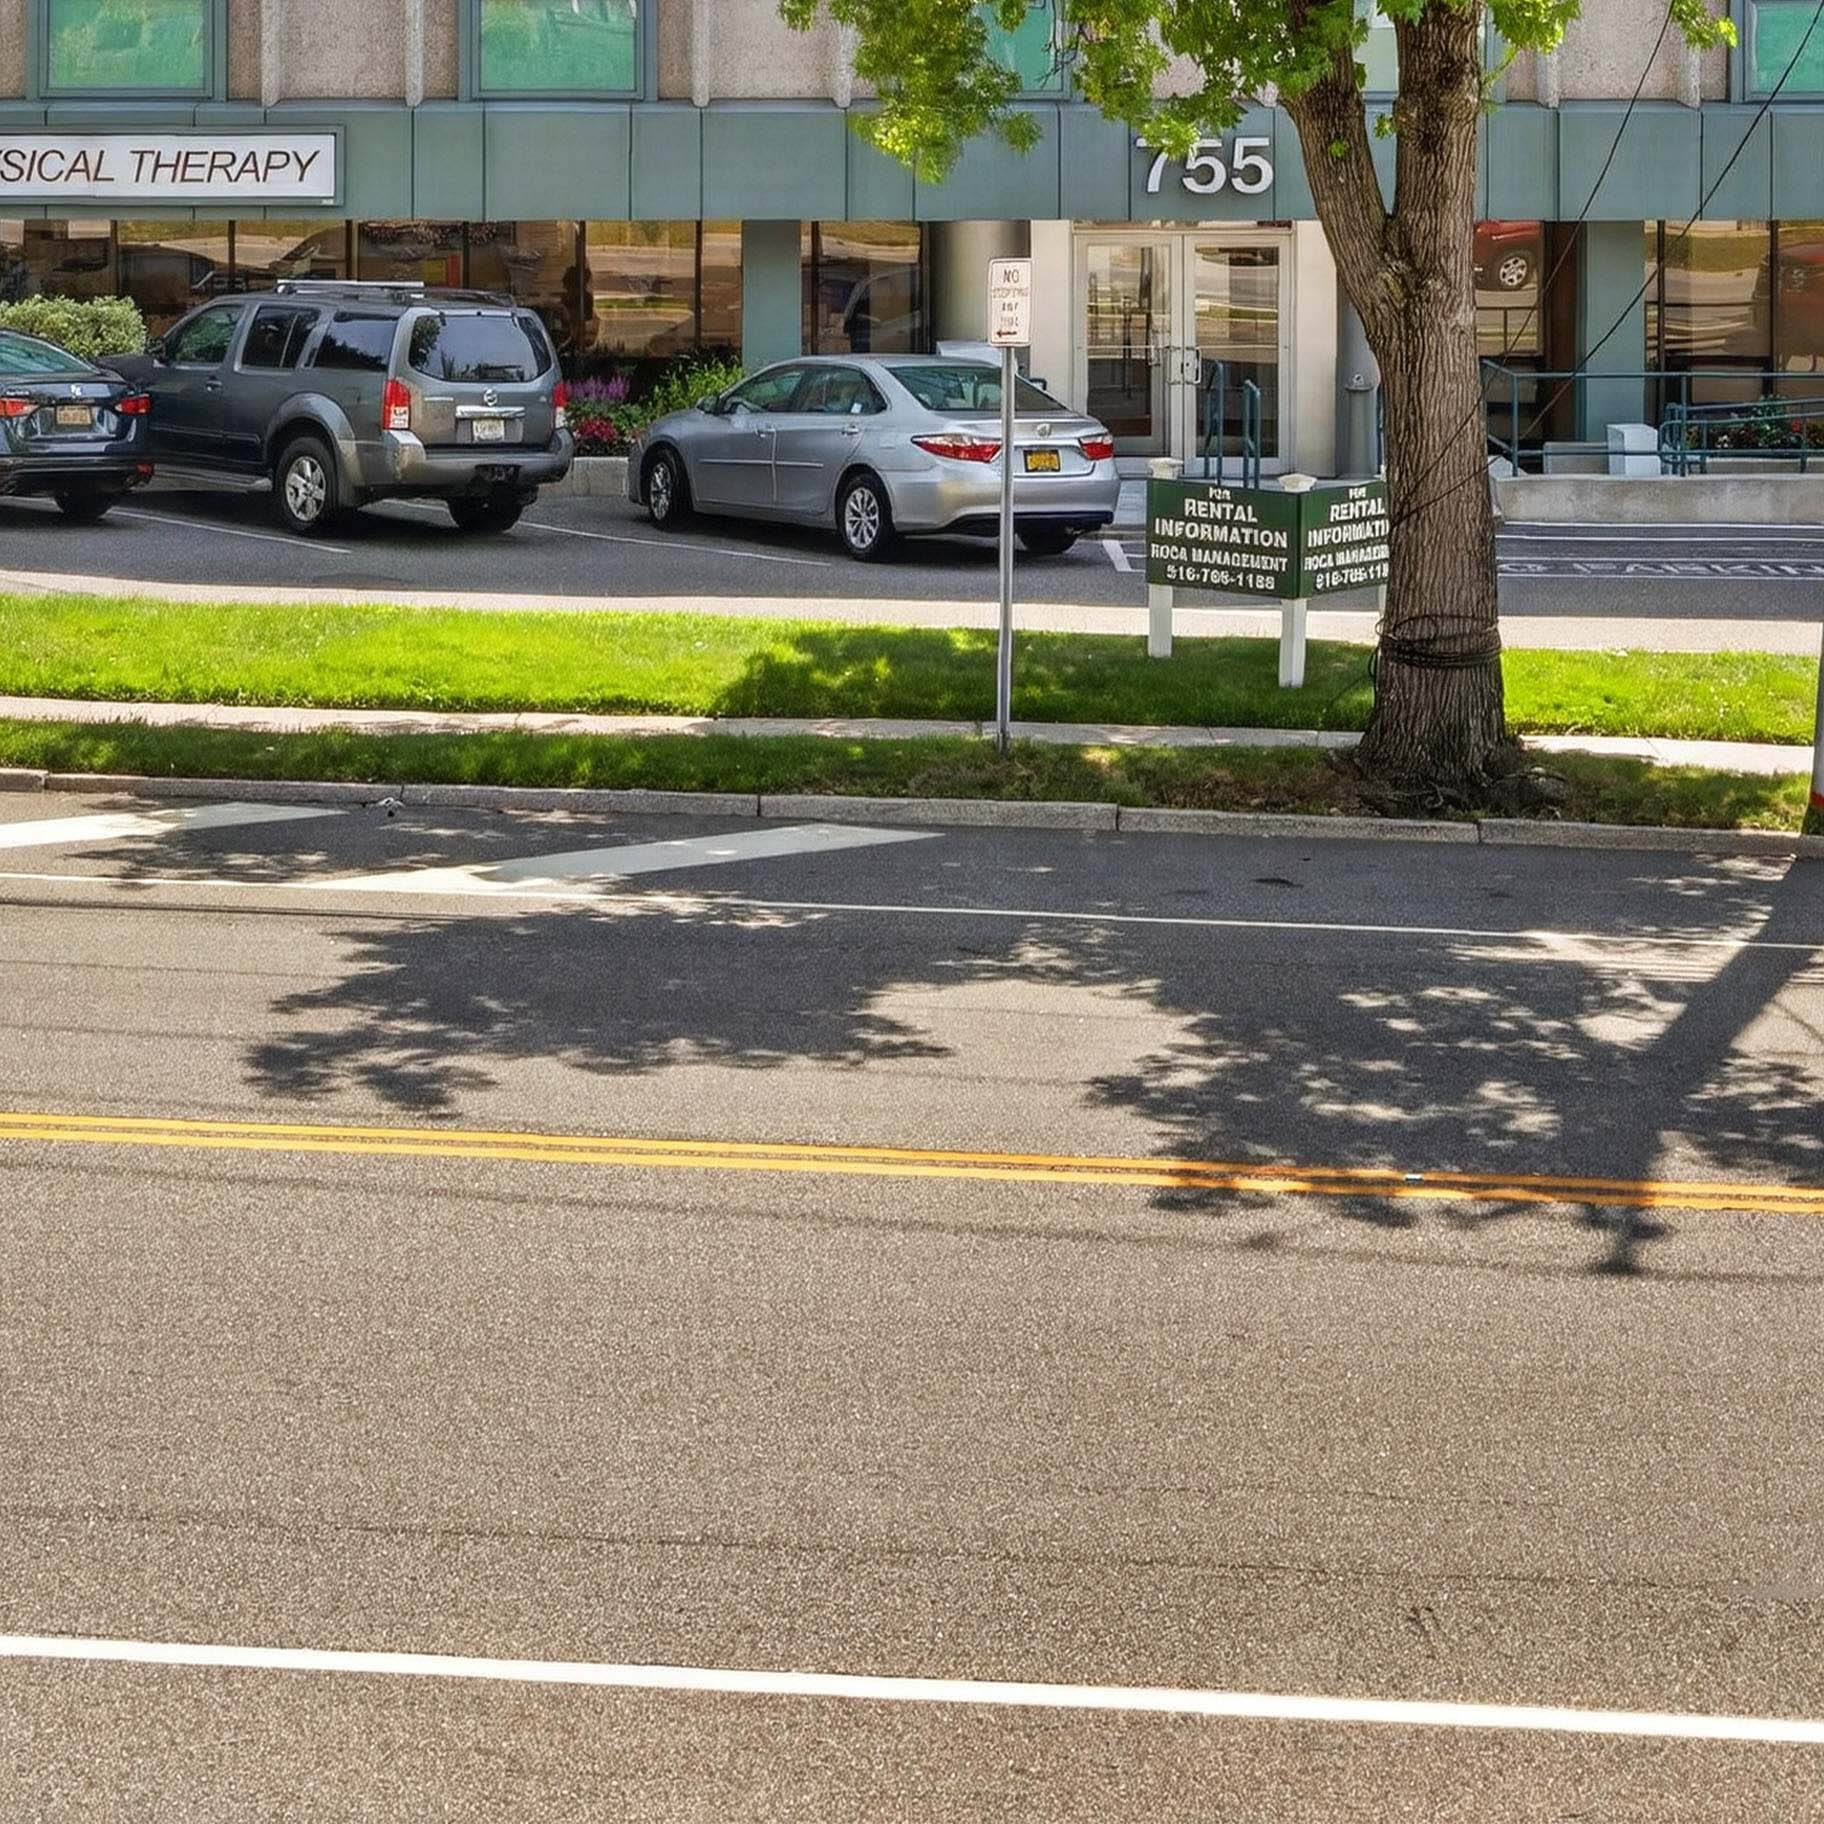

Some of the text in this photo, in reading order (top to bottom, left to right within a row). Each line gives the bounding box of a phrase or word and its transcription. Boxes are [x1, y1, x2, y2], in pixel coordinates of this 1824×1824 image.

[130, 150, 321, 184] THERAPY
[1136, 137, 1273, 194] 755
[1003, 269, 1020, 284] NO
[1184, 498, 1258, 523] RENTAL
[1330, 498, 1386, 522] RENTAL
[1155, 518, 1288, 549] INFORMATION
[1308, 520, 1390, 547] INFORMATI
[1150, 543, 1288, 572] ROCA MANAGEMENT
